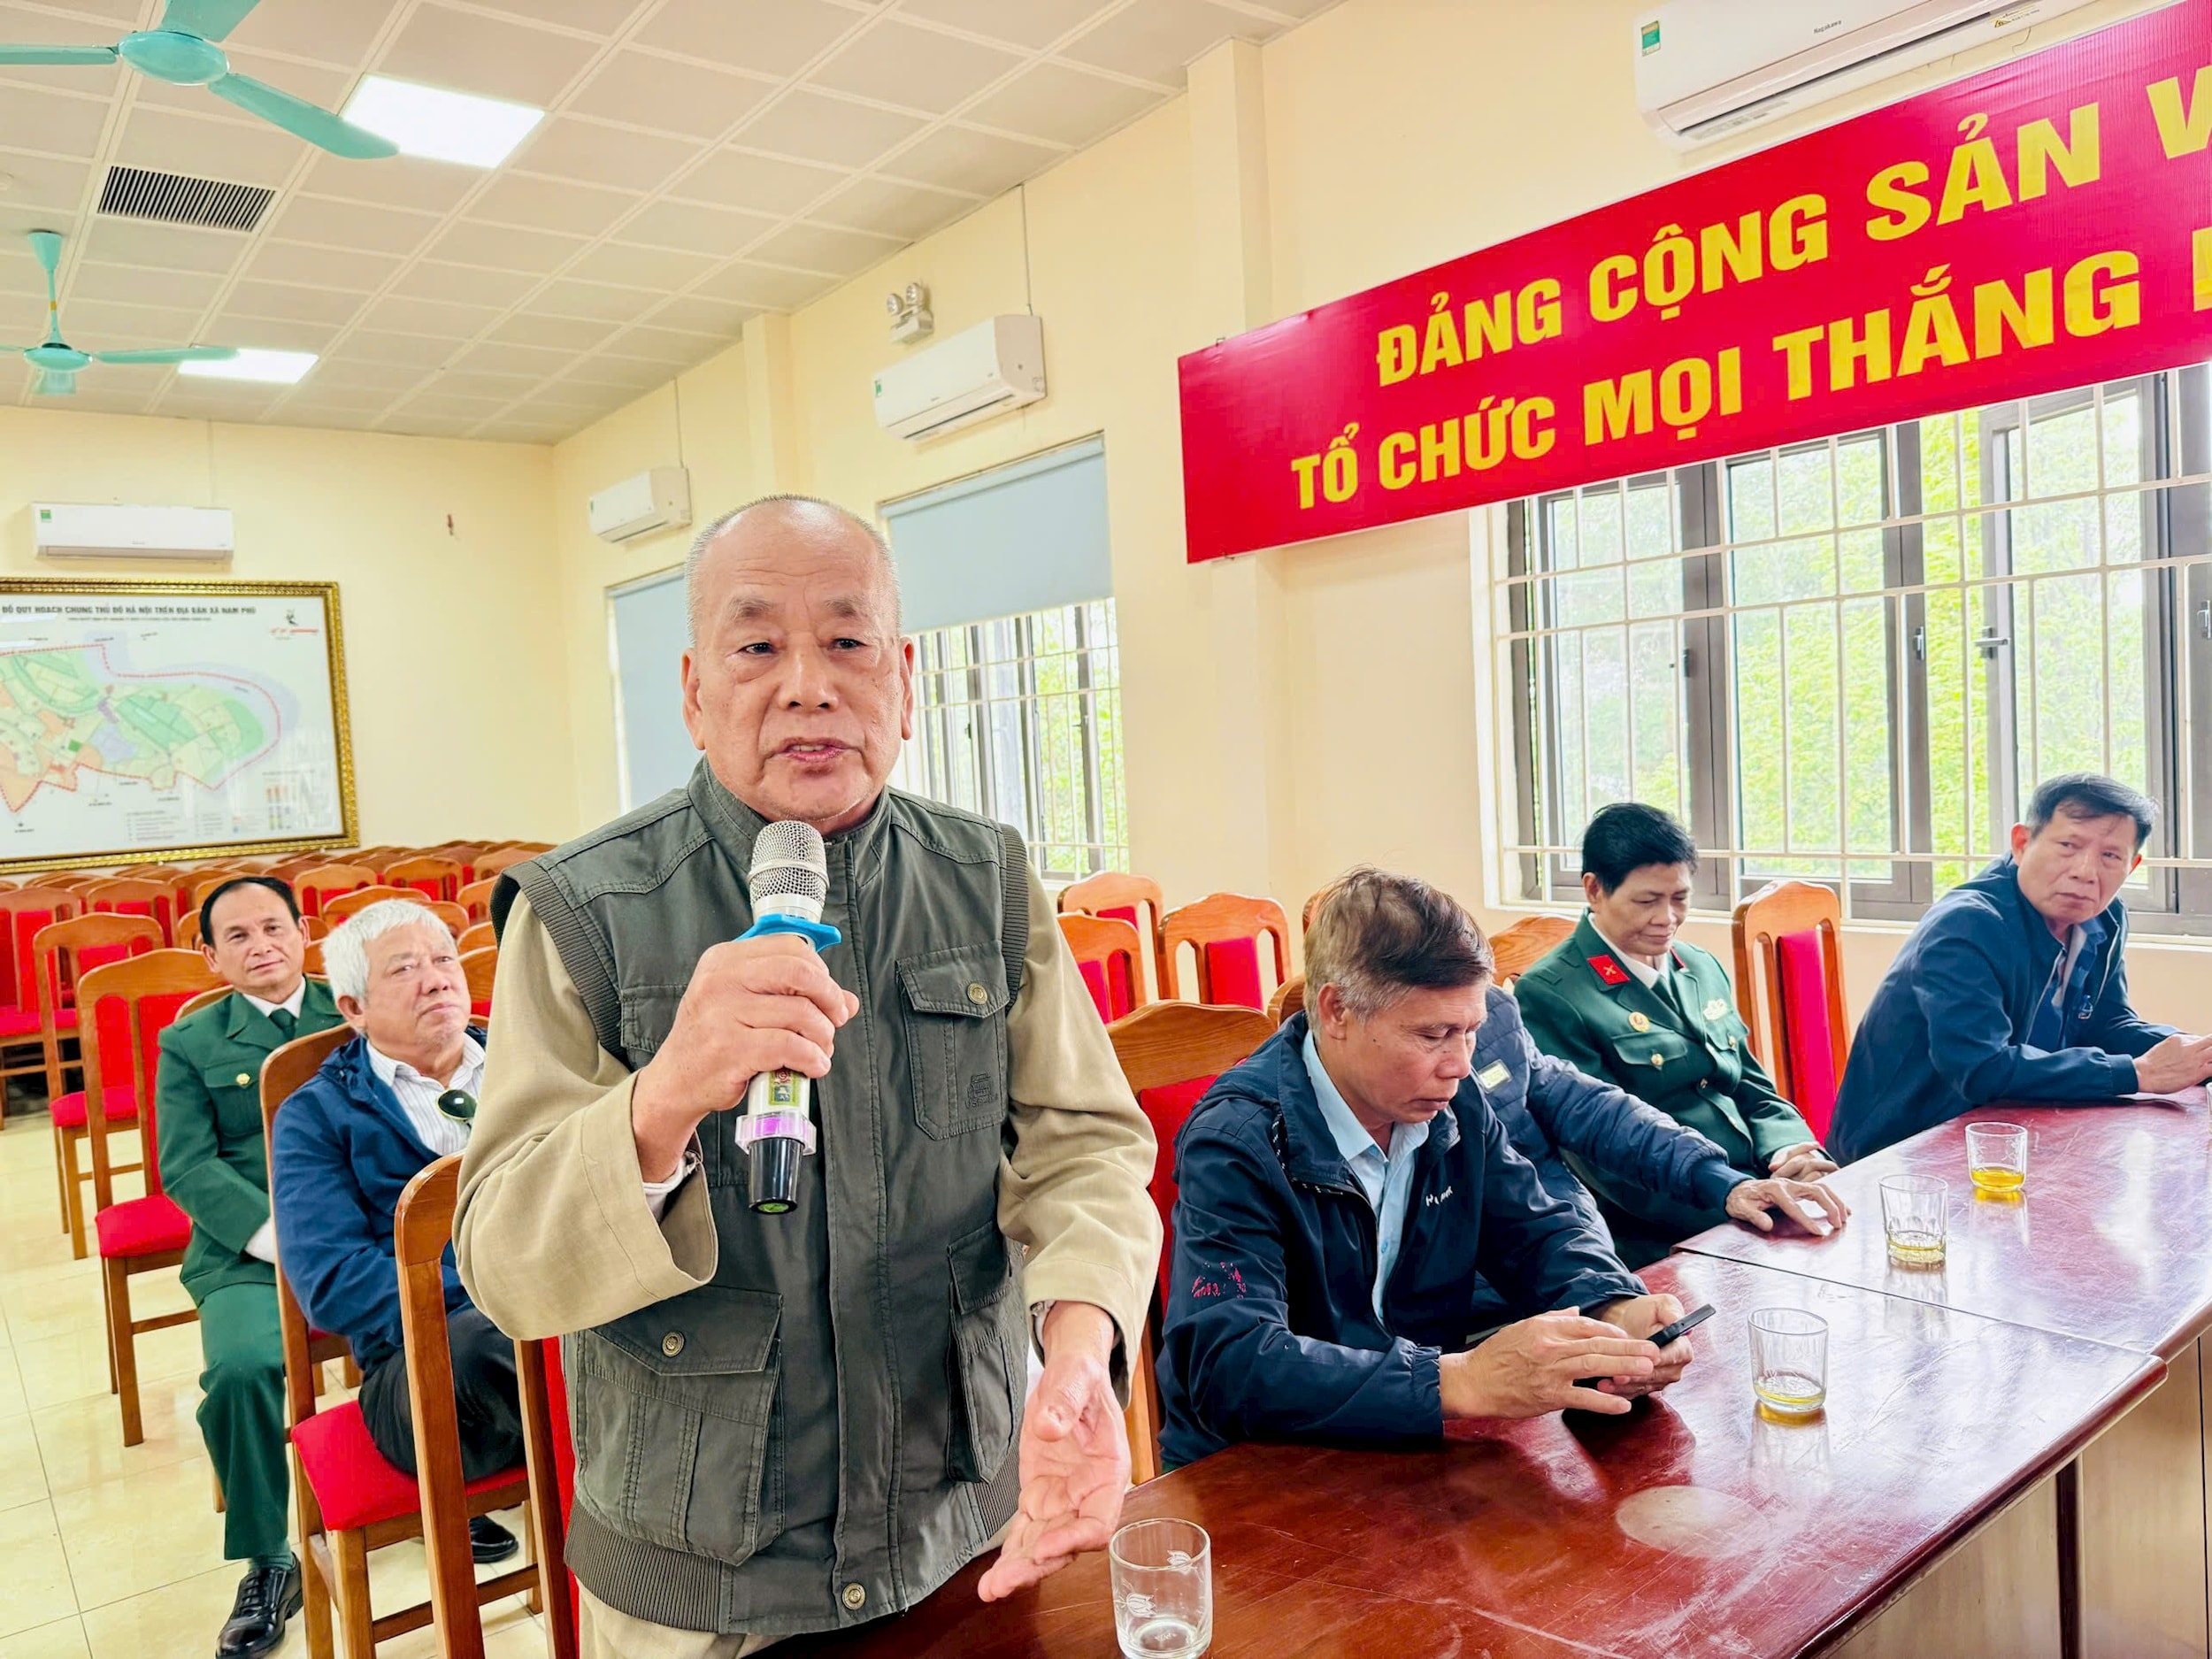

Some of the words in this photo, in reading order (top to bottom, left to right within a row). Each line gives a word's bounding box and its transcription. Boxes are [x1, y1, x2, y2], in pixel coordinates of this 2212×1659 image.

[1377, 277, 1561, 387] ĐẢNG
[1590, 194, 1827, 321] CỘNG
[1867, 104, 2101, 241] SẢN
[2146, 64, 2212, 159] V
[1292, 423, 1359, 508] TỔ
[1379, 396, 1555, 490] CHỨC
[1585, 348, 1740, 444] MỌI
[1773, 250, 2140, 400] THẮNG
